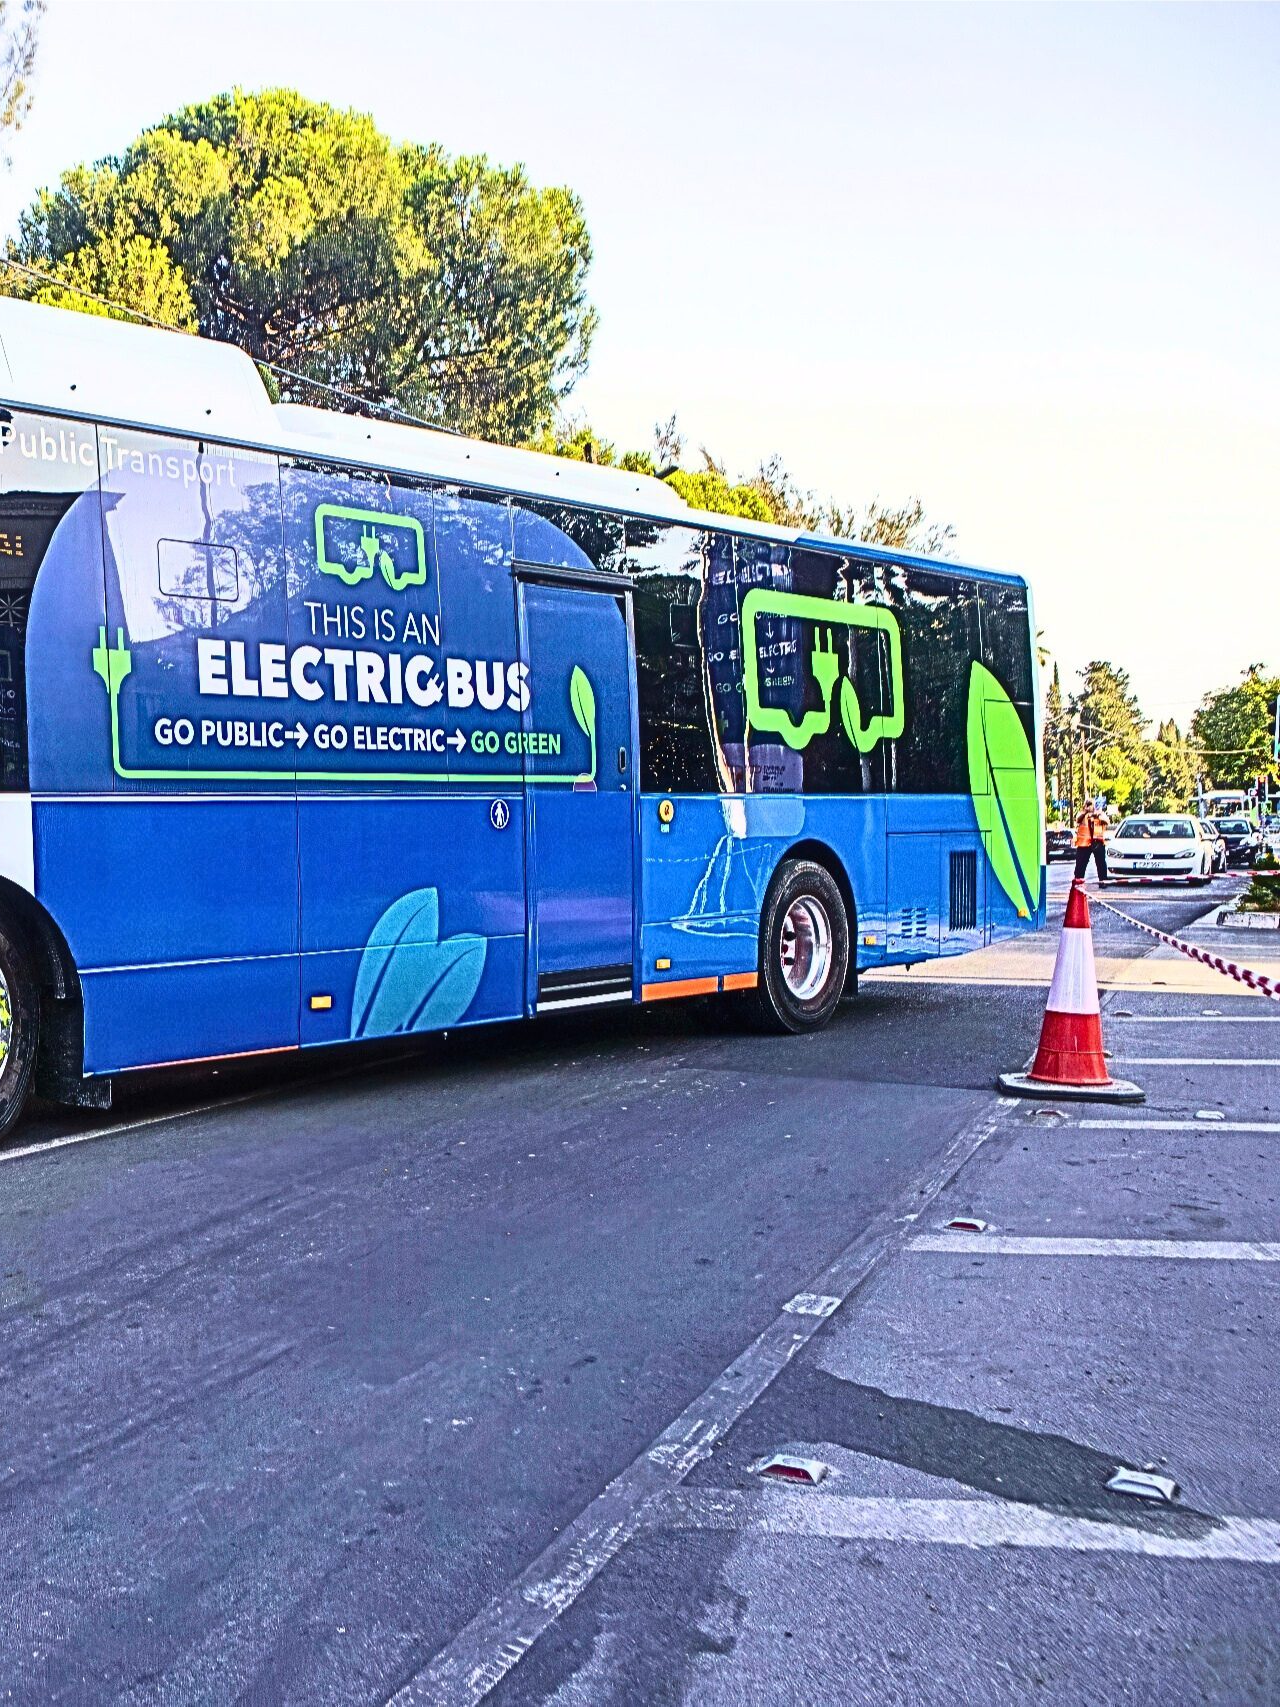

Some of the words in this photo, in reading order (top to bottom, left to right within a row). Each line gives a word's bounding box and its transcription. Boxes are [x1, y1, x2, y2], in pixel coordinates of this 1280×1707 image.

[100, 436, 237, 488] Transport
[304, 600, 366, 639] THIS
[375, 608, 398, 642] IS
[402, 613, 441, 646] AN
[197, 638, 445, 707] ELECTRIC
[446, 658, 531, 712] BUS
[154, 718, 195, 746] GO
[201, 719, 284, 748] PUBLIC
[314, 724, 348, 749] GO
[353, 725, 446, 752] ELECTRIC
[470, 730, 500, 753] GO
[504, 732, 562, 755] GREEN
